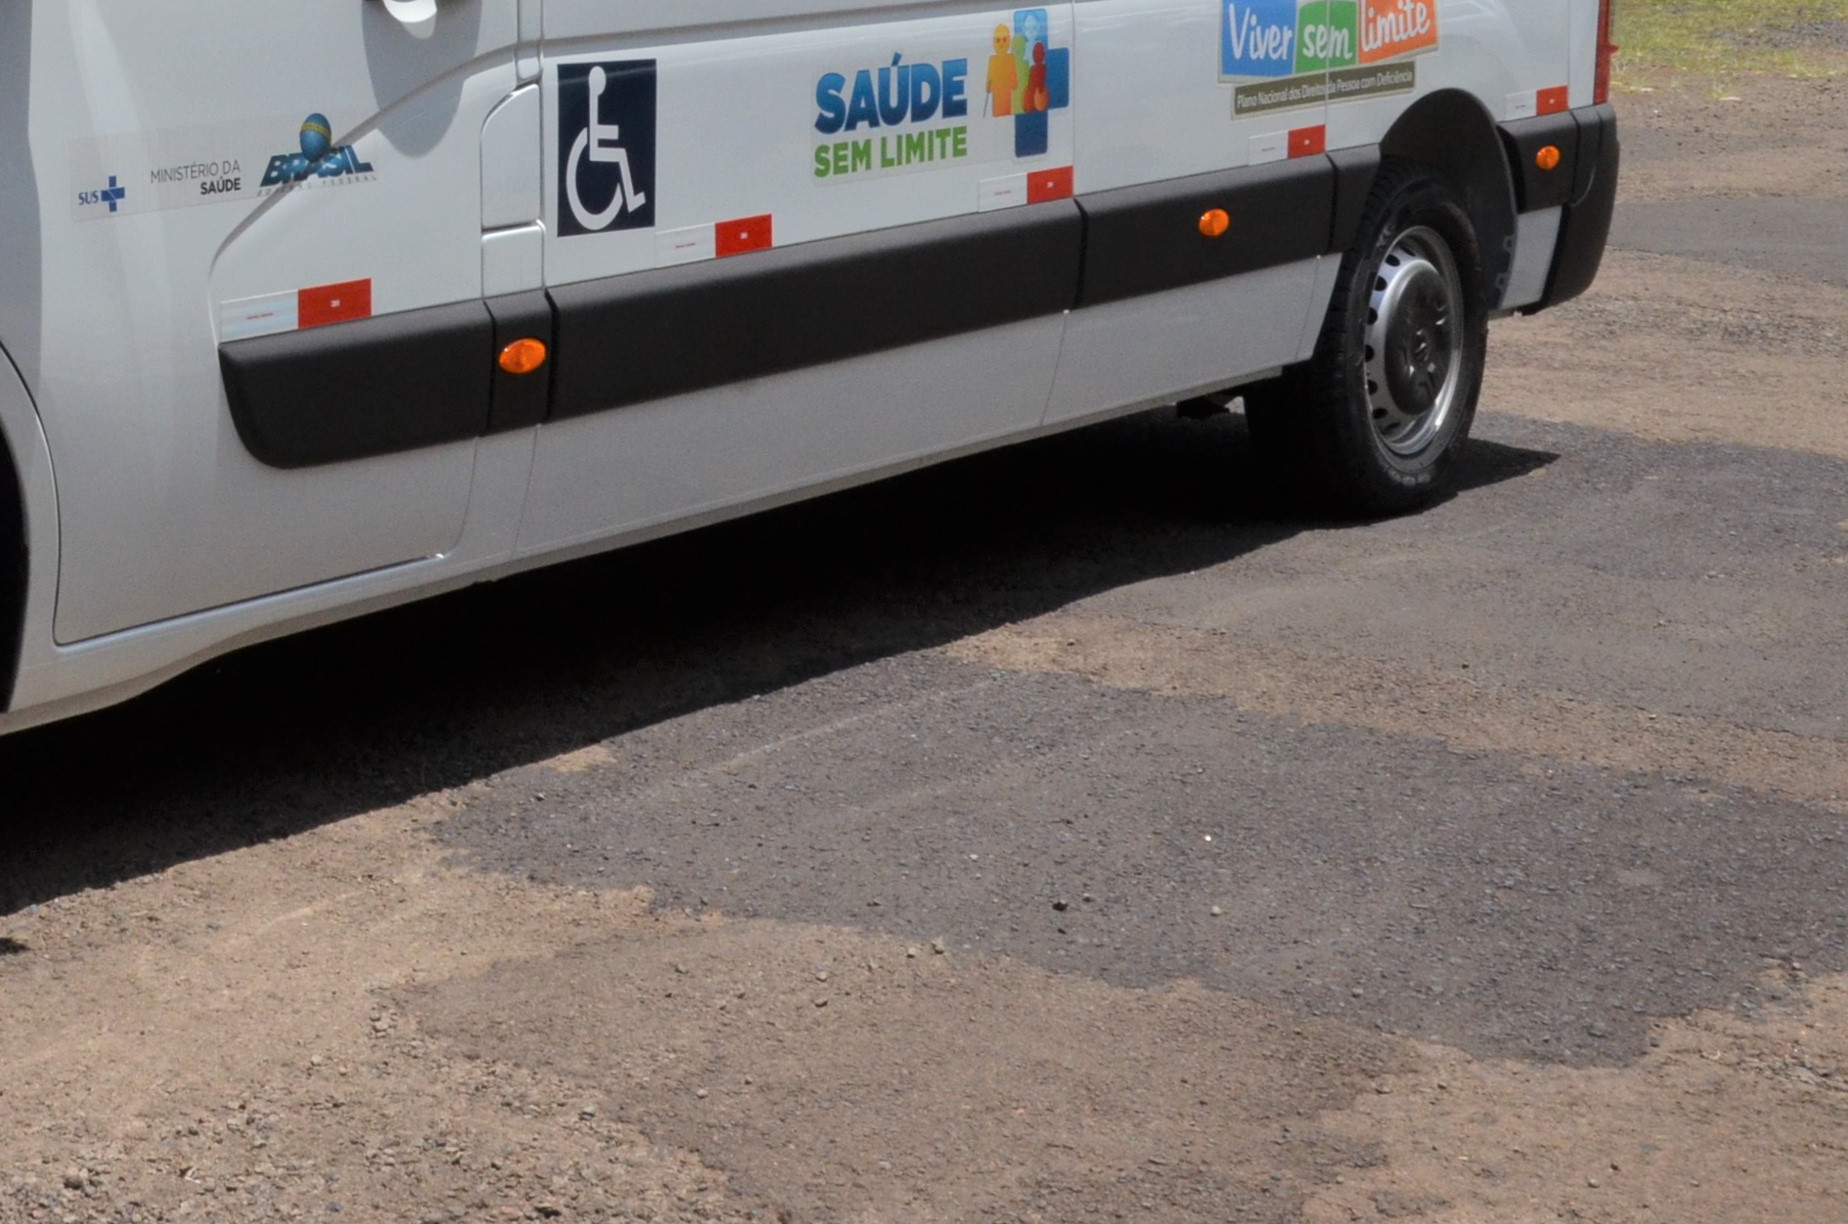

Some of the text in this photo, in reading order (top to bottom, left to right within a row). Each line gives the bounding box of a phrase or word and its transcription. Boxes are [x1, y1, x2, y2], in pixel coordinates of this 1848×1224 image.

[1228, 3, 1293, 60] Viver
[1302, 24, 1353, 59] sem
[814, 52, 968, 134] SAÚDE
[150, 160, 240, 184] MINISTÉRIO DA
[260, 144, 374, 187] BRASIL
[814, 125, 968, 178] SEM LIMITE
[78, 190, 99, 205] SUS
[200, 176, 241, 195] SAÚDE
